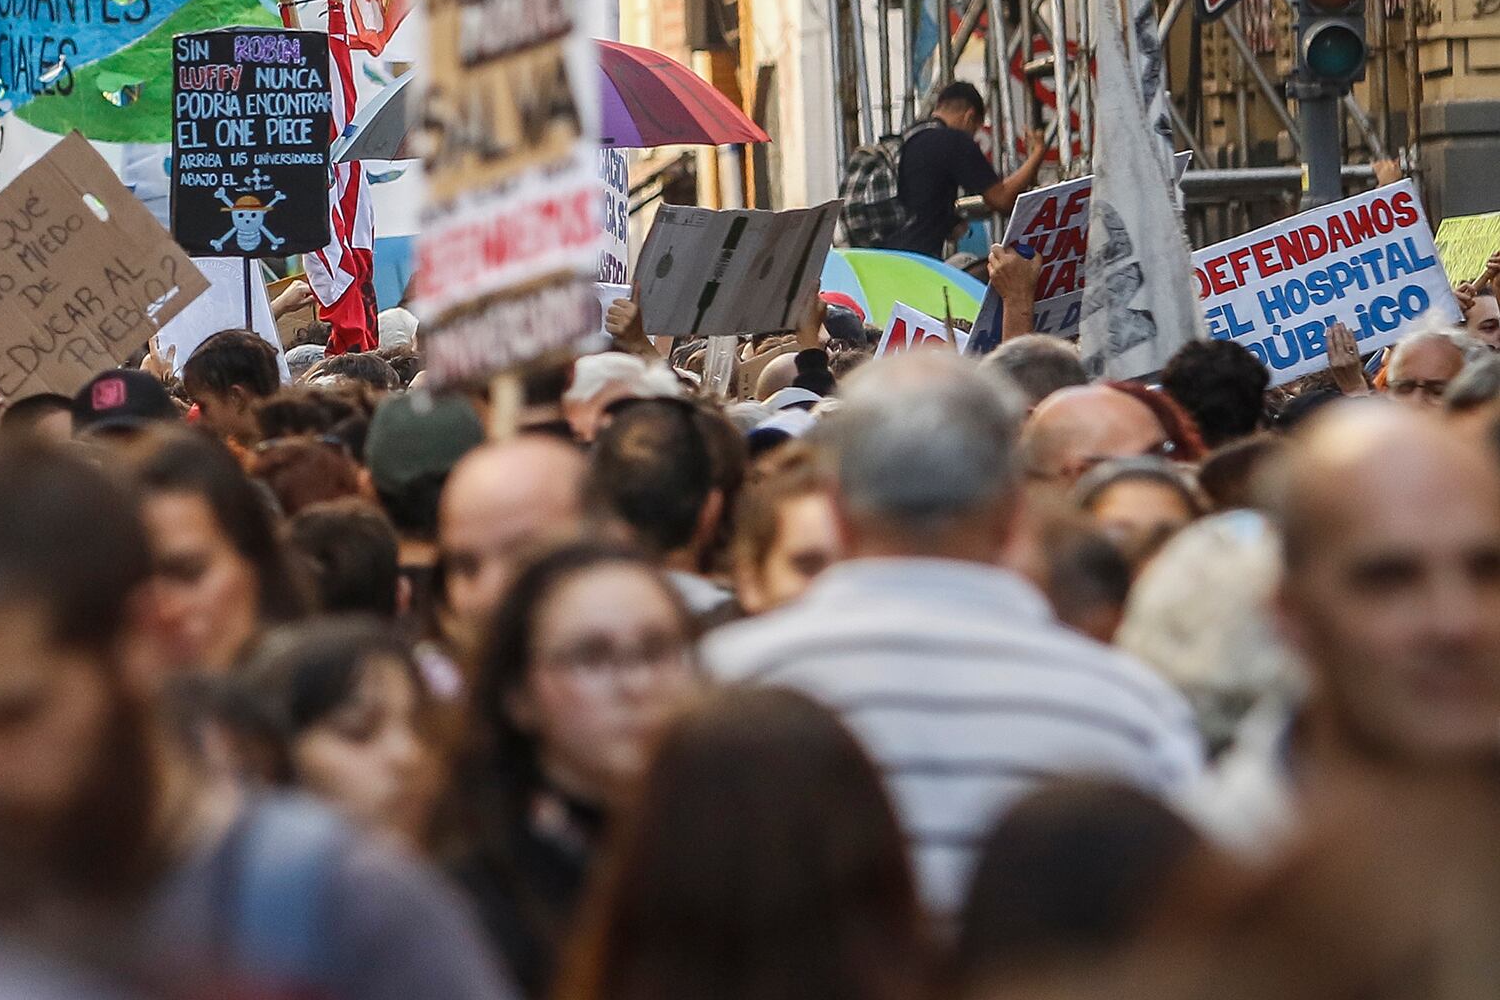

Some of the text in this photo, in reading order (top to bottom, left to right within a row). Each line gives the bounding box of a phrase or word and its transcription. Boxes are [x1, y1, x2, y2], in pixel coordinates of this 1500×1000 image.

[178, 64, 323, 91] LUFFY NUNCA
[176, 91, 242, 120] PODRÍA
[177, 121, 208, 149] EL
[215, 119, 257, 147] ONE
[179, 173, 239, 187] ABAJO EL
[16, 212, 84, 274] MIEDO
[1191, 191, 1419, 301] DEFENDAMOS
[103, 255, 146, 297] AL
[18, 277, 61, 310] DE
[1205, 301, 1256, 342] EL
